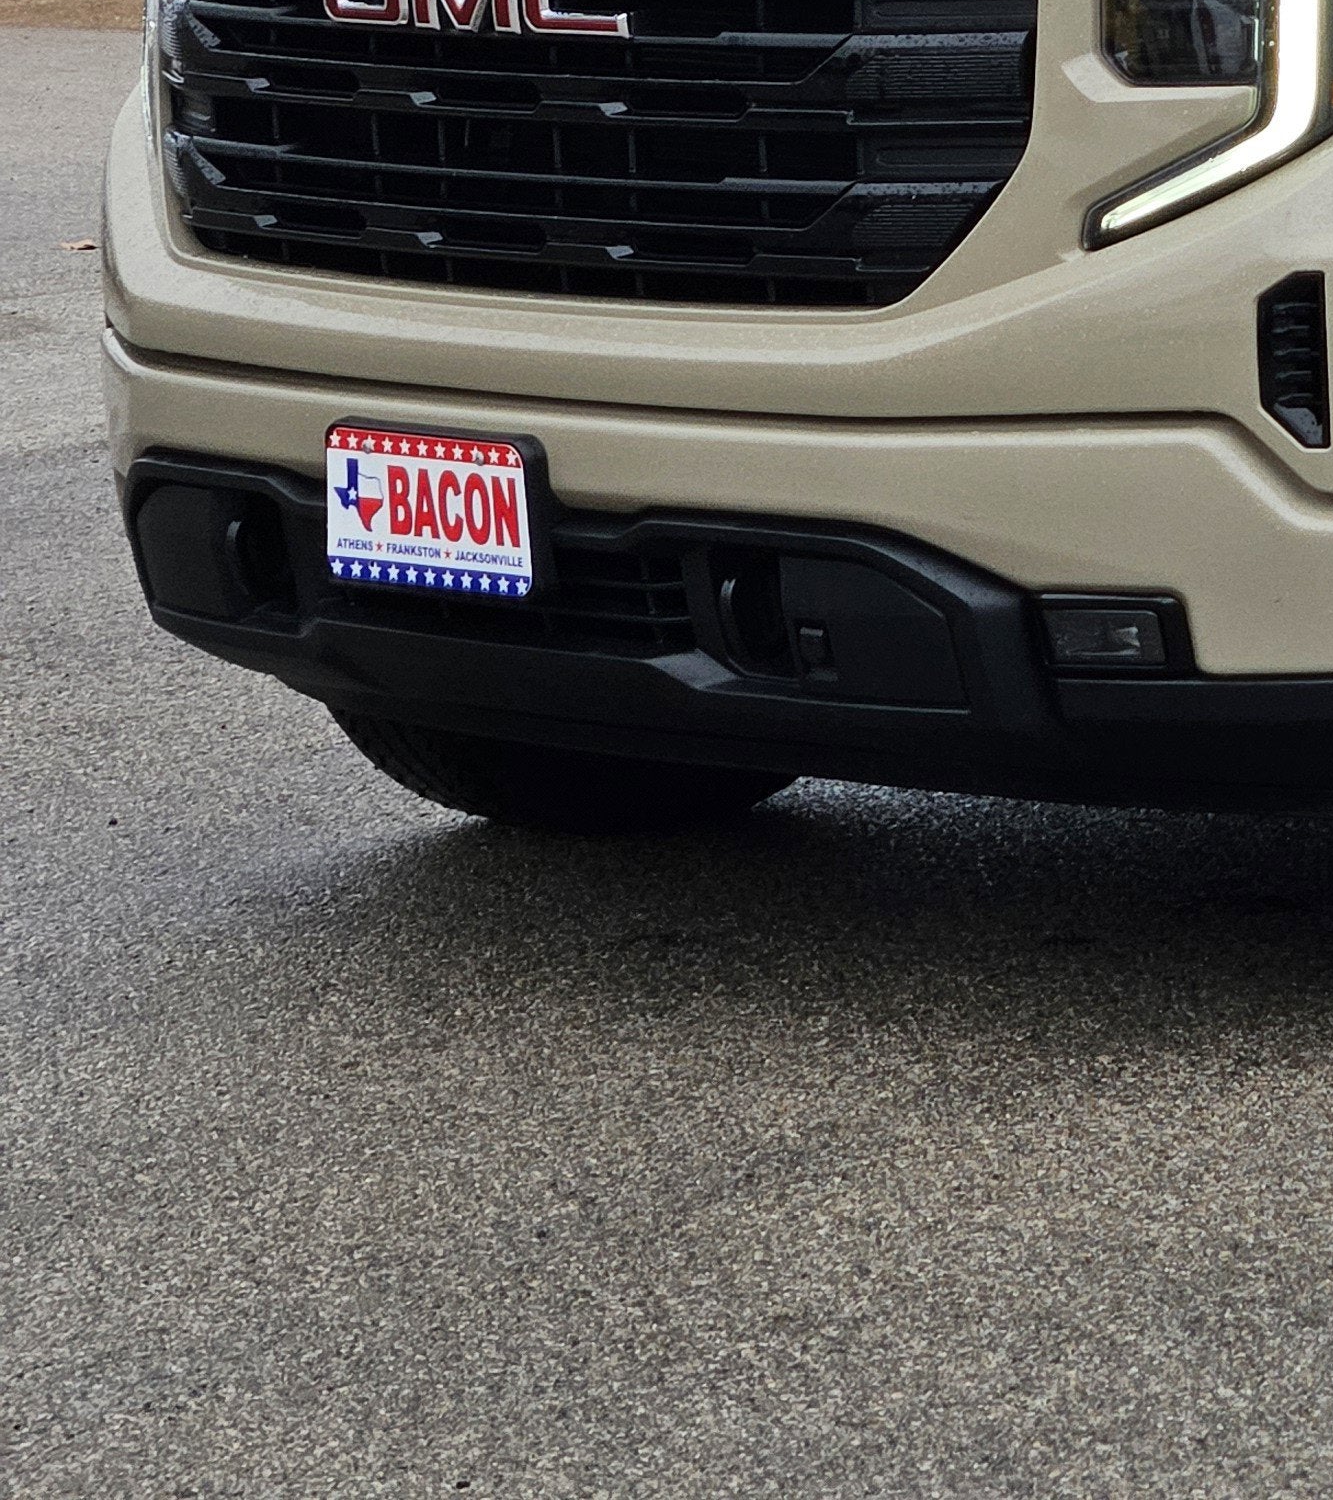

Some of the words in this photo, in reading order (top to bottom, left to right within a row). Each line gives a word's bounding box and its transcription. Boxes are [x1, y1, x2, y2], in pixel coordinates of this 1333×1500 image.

[387, 464, 521, 548] BACON
[337, 538, 373, 551] ATHENS
[386, 542, 441, 559] FRANKSTON
[454, 551, 524, 568] JACKSONVILLE
